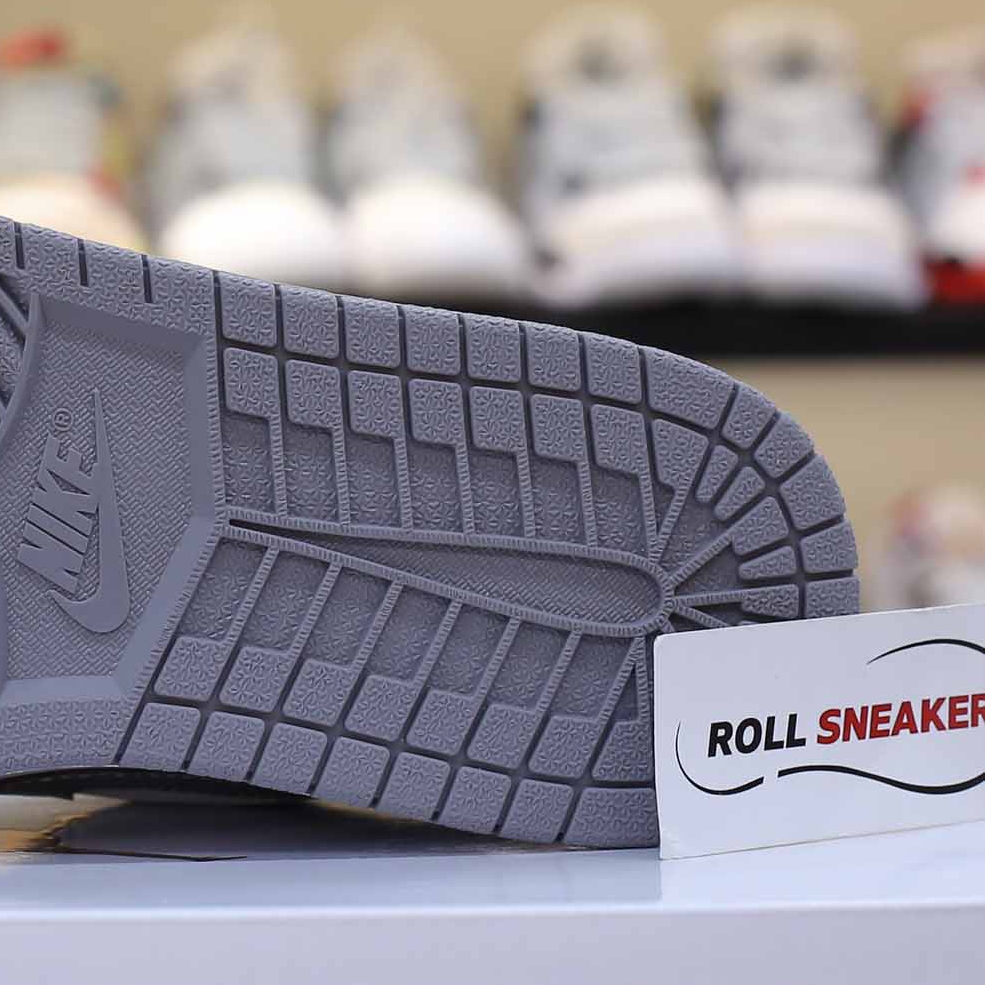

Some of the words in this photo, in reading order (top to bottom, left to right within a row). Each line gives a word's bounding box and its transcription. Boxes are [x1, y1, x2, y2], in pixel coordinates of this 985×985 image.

[17, 432, 98, 595] NIKE
[707, 713, 806, 757] ROLL
[816, 693, 985, 744] SNEAKER
